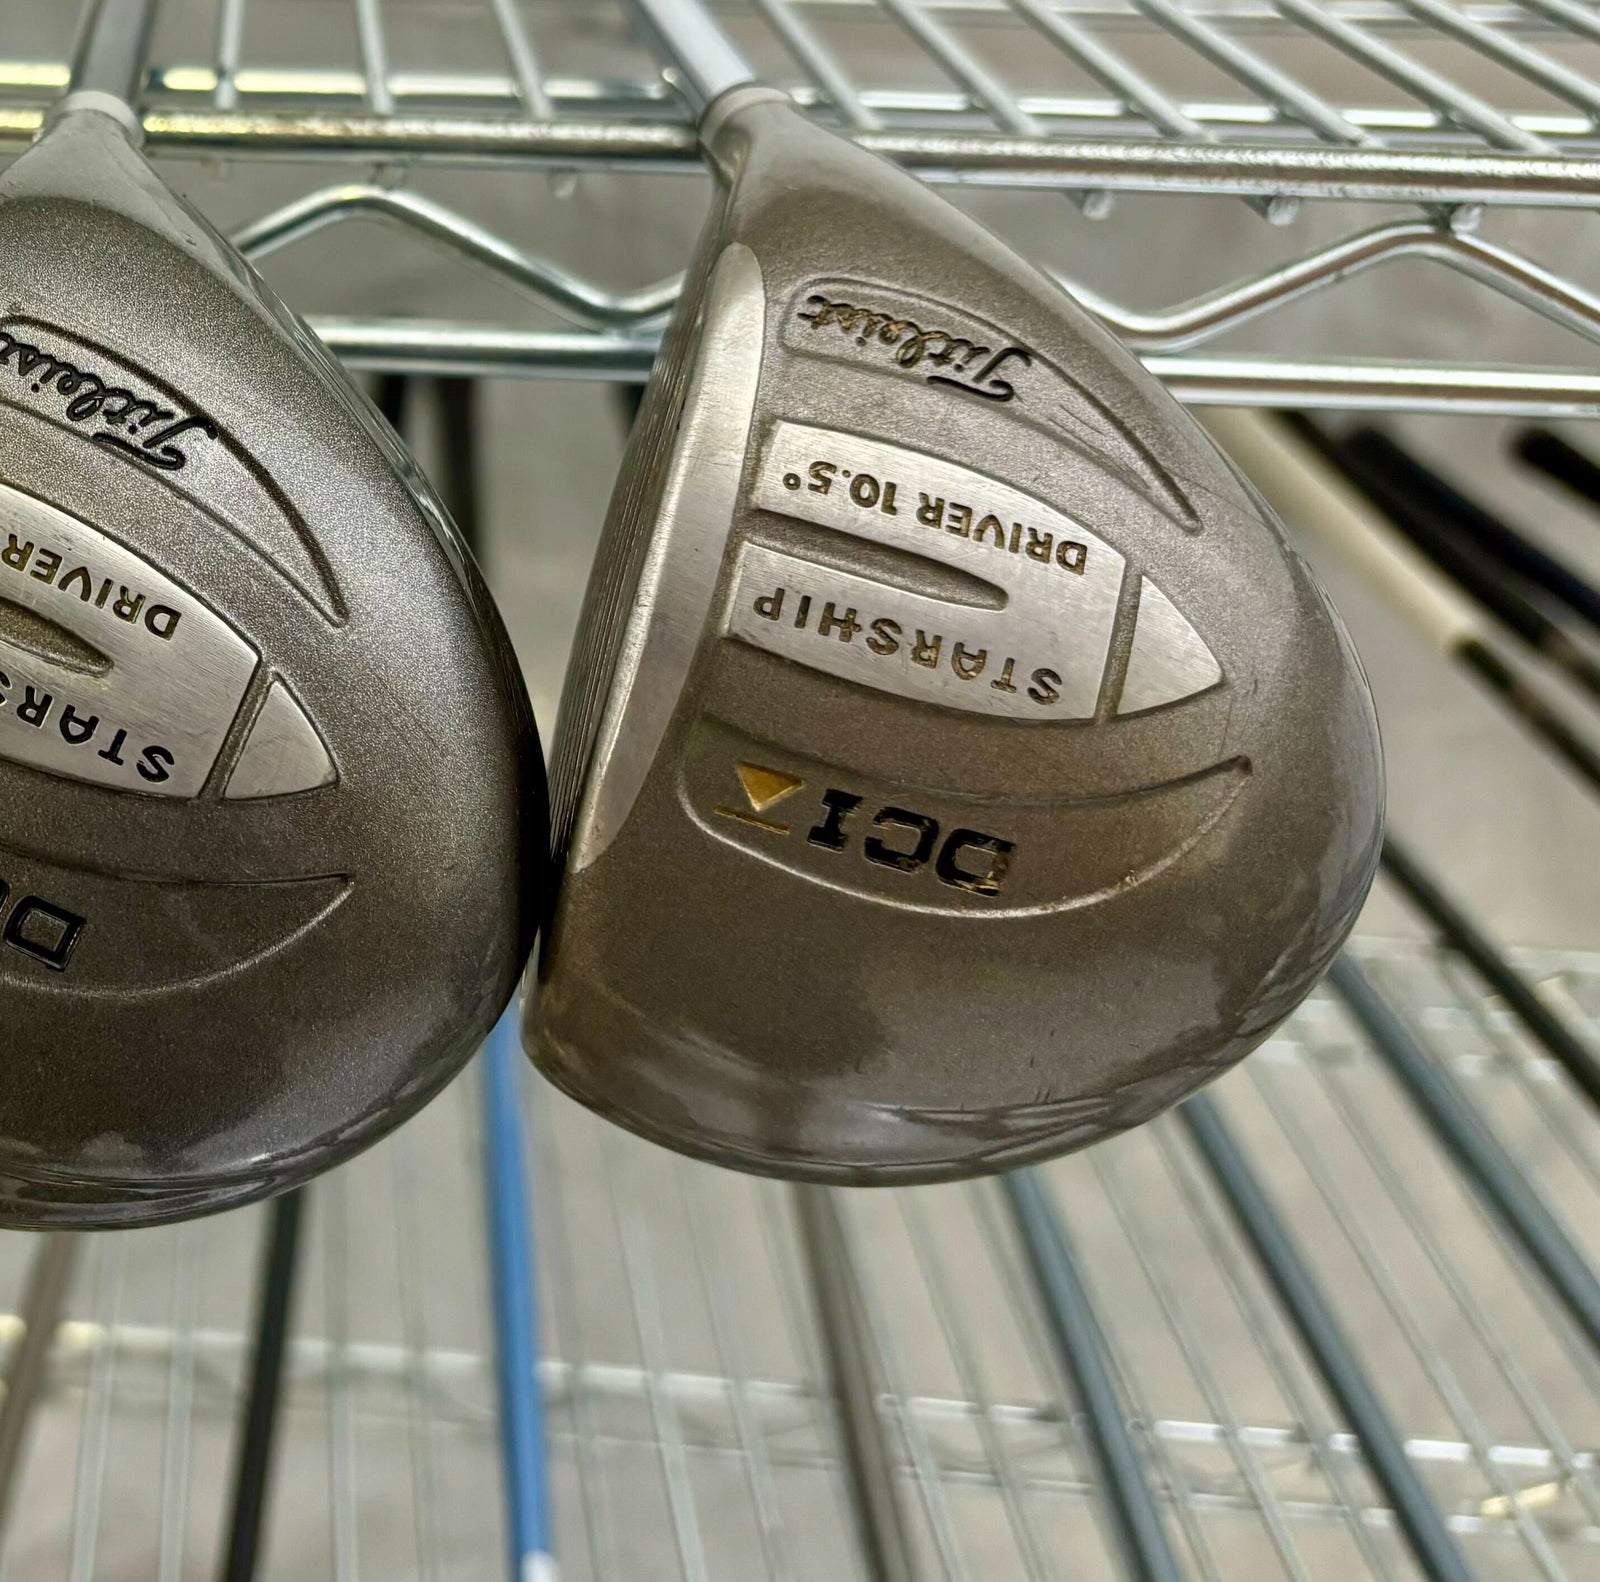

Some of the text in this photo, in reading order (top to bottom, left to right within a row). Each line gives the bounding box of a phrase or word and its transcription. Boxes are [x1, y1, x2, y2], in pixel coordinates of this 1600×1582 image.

[797, 294, 1032, 402] Titleist
[782, 460, 1088, 576] DRIVER 10.5°
[1, 533, 182, 641] DRIVER
[752, 586, 1063, 705] STARSHIP
[807, 788, 1015, 898] DCI
